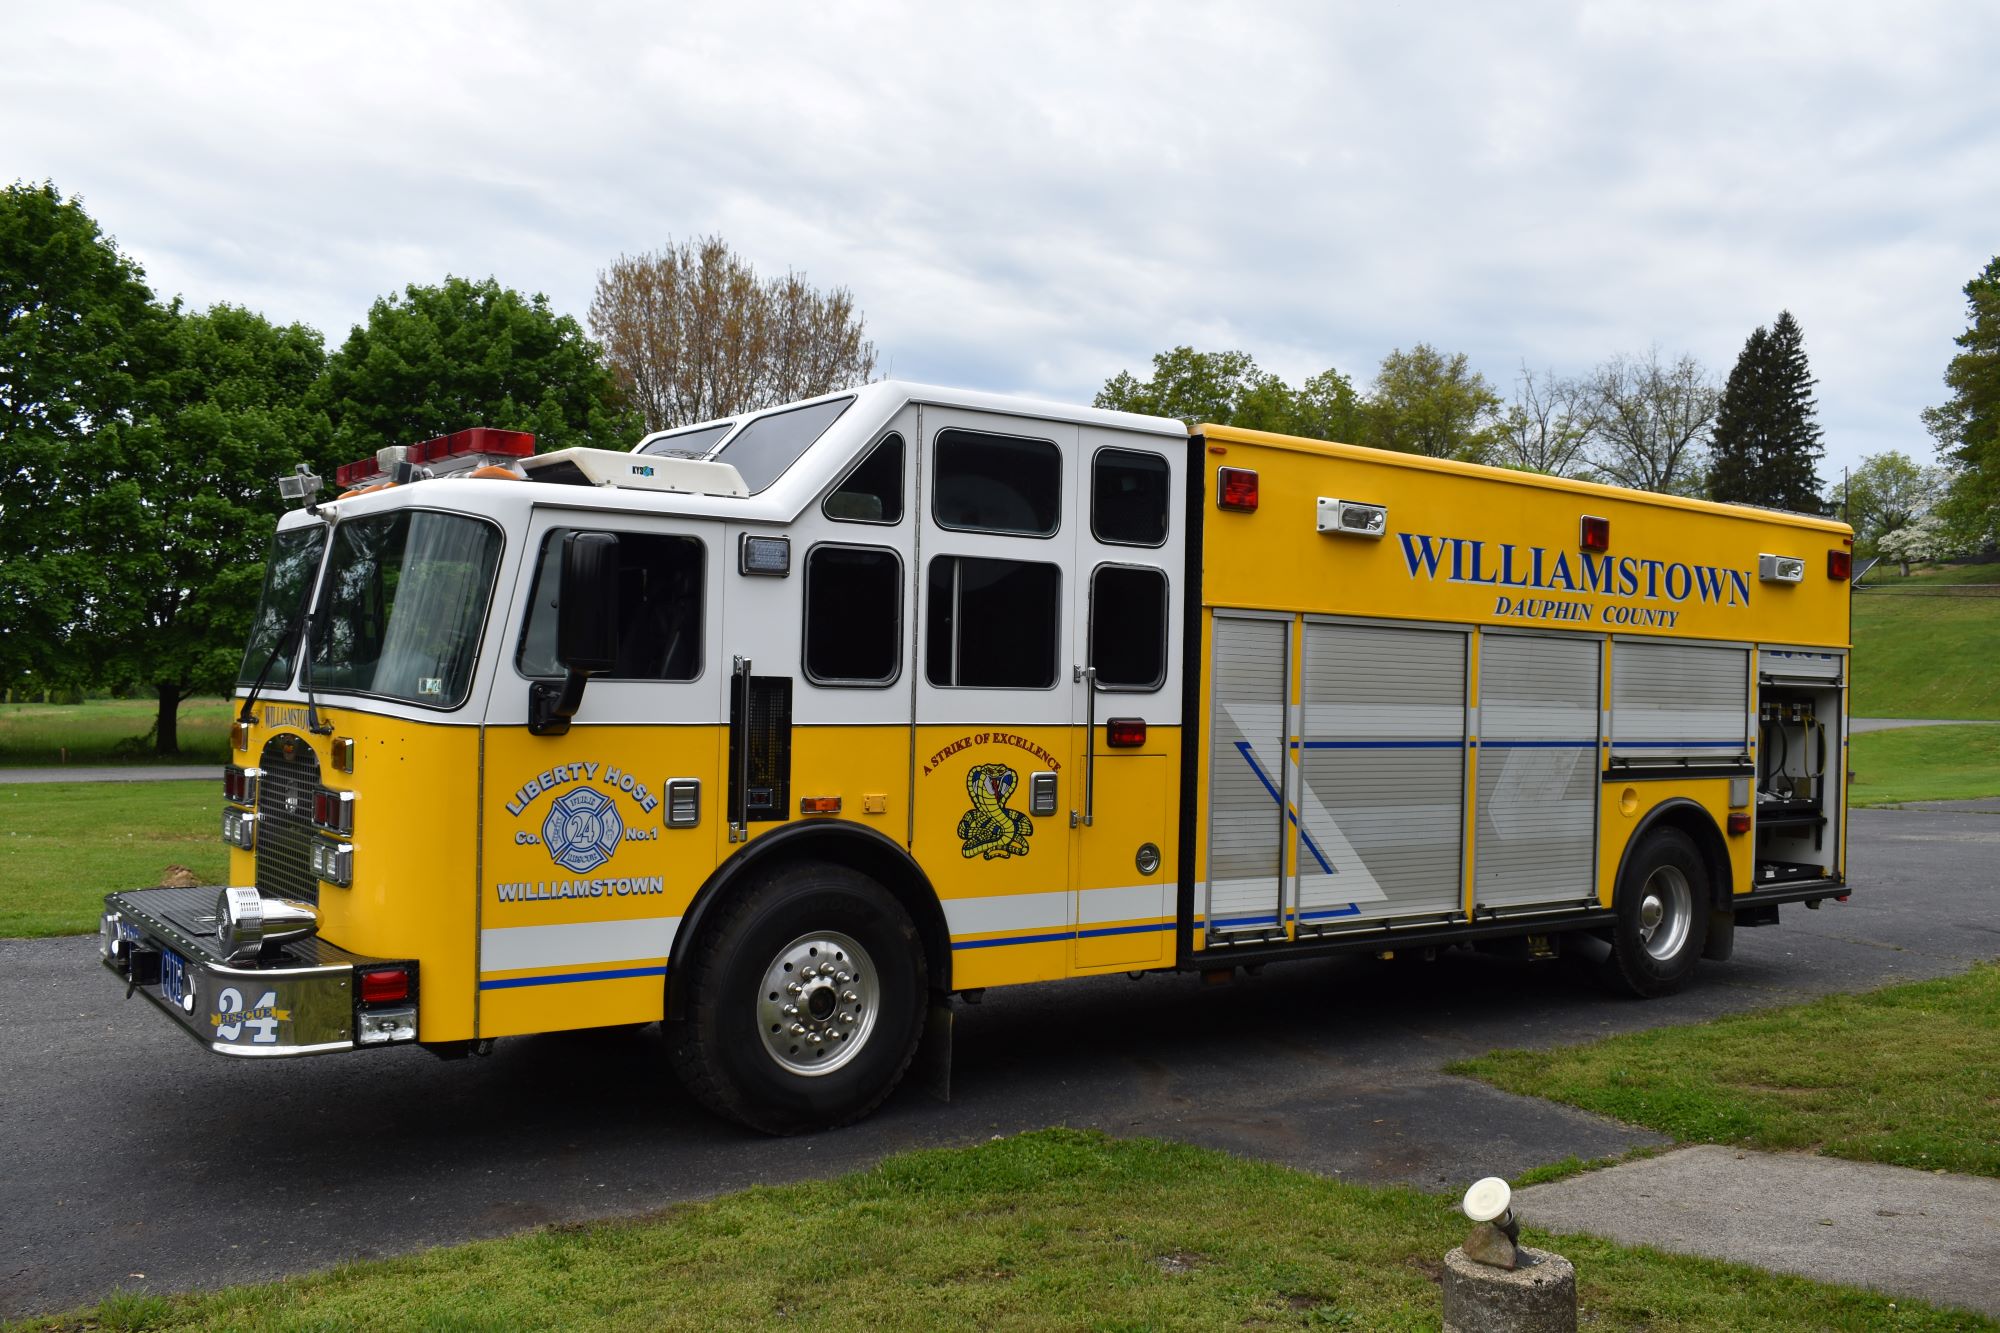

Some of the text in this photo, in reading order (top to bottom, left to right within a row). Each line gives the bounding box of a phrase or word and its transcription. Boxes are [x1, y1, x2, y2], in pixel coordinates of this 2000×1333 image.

[1396, 532, 1752, 607] WILLIAMSTOWN
[1492, 596, 1680, 629] DAUPHIN COUNTY
[923, 732, 1062, 777] A STRIKE OF EXCELLENCE
[505, 762, 659, 817] LIBERTY HOSE
[515, 831, 540, 845] Co.
[571, 815, 595, 844] 24
[497, 876, 664, 902] WILLIAMSTOWN
[216, 986, 279, 1043] 24
[221, 1006, 273, 1024] RESCUE
